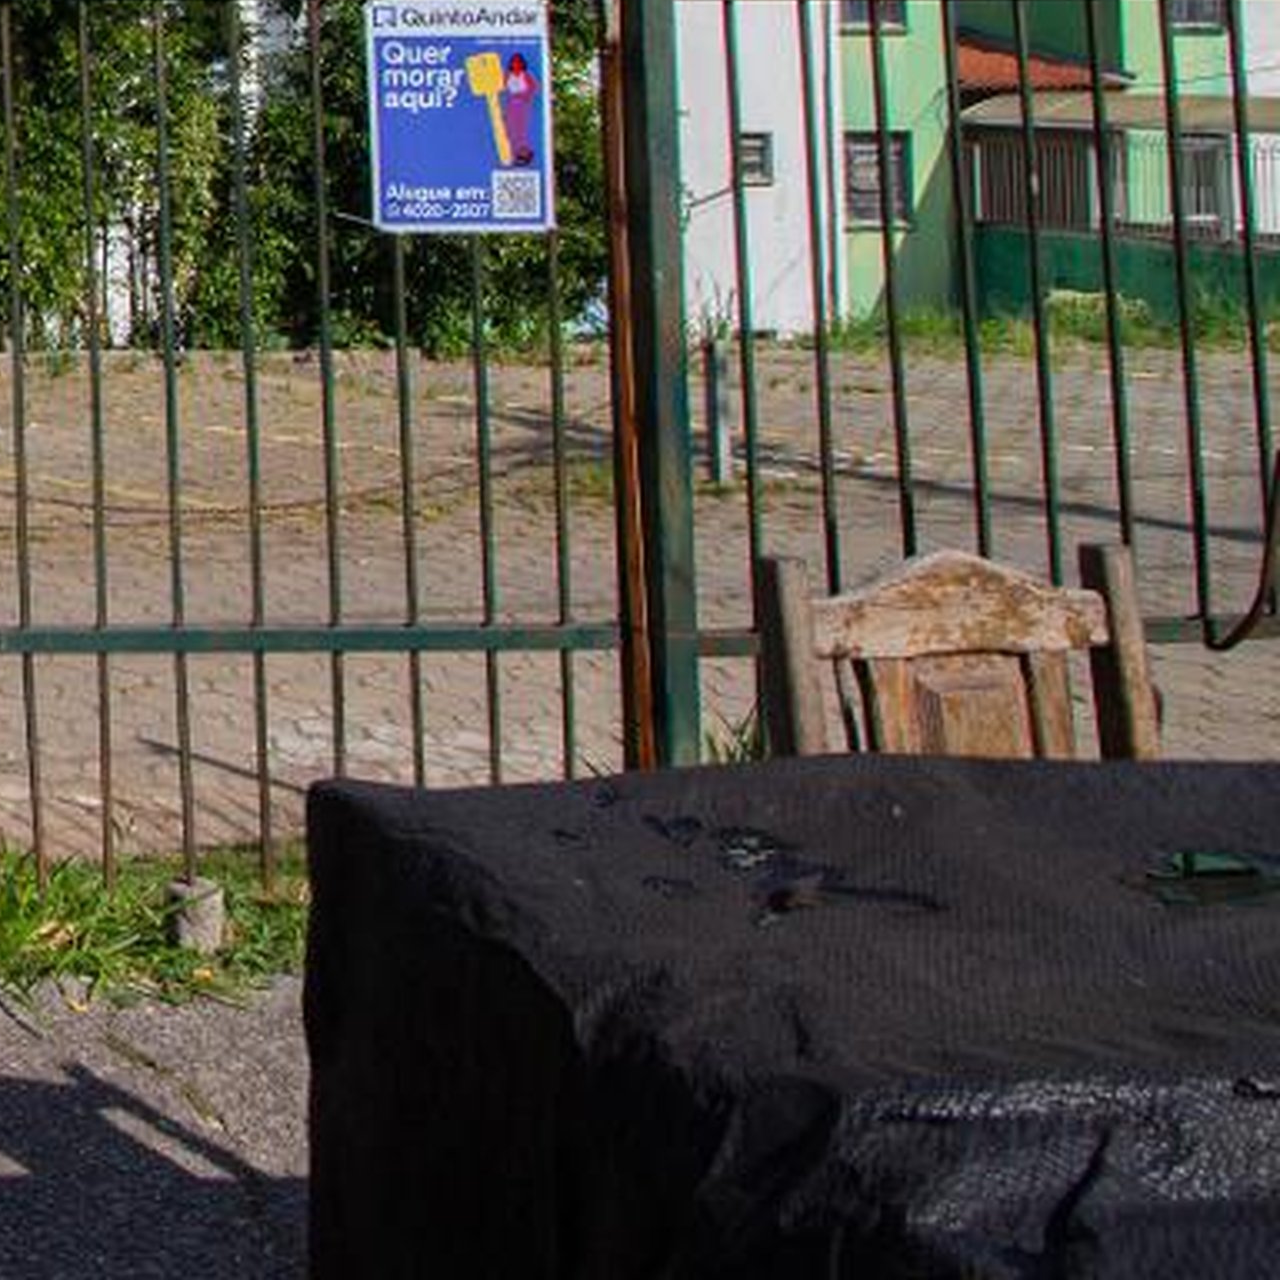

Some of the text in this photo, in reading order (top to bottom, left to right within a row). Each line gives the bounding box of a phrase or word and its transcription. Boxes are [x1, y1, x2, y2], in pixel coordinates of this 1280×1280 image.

[401, 8, 536, 27] QuintoAndar
[382, 41, 451, 65] Quer
[382, 68, 465, 87] morar
[384, 86, 458, 113] aqui?
[387, 184, 451, 202] Alugue
